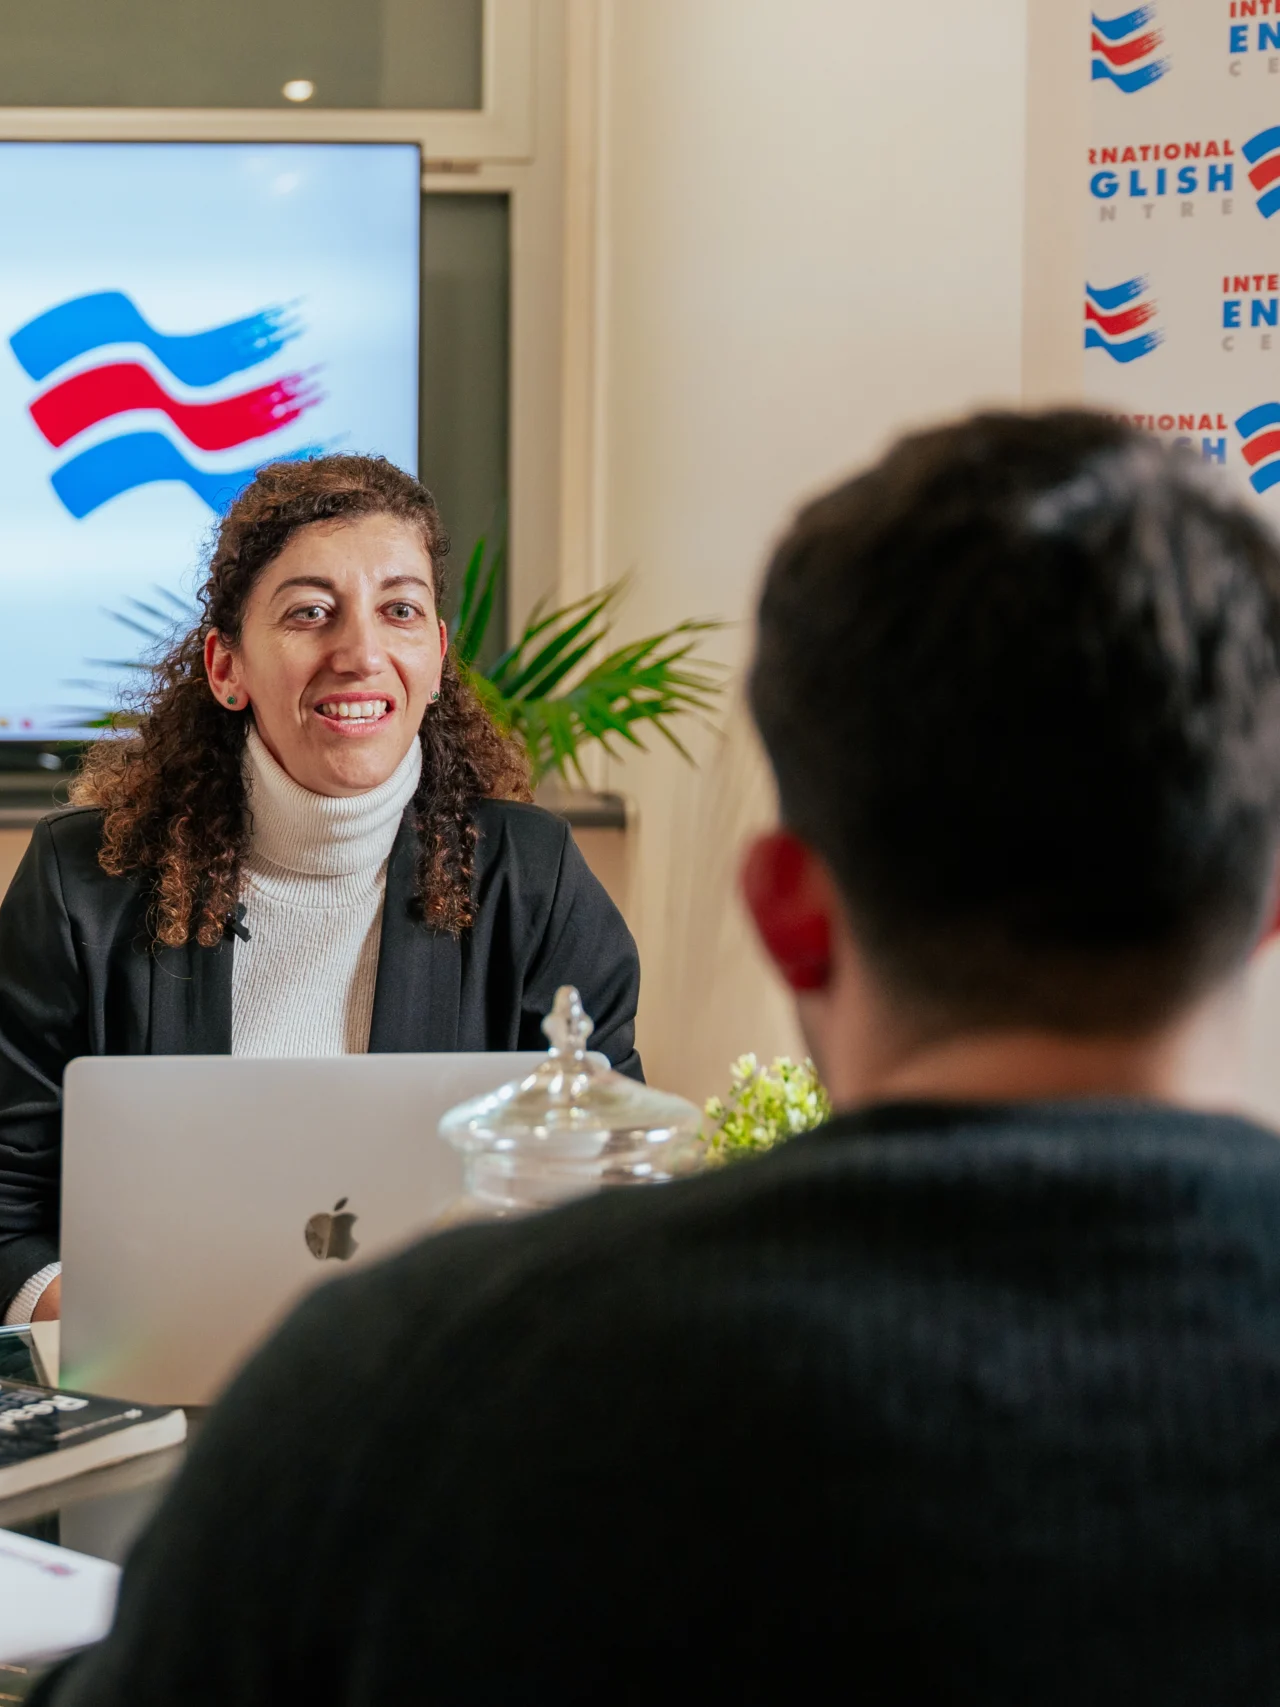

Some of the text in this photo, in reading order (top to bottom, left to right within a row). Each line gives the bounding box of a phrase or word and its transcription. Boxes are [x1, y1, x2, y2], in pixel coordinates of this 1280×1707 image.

[1089, 163, 1234, 199] GLISH
[1099, 198, 1233, 222] NTRE
[1222, 298, 1279, 328] EN
